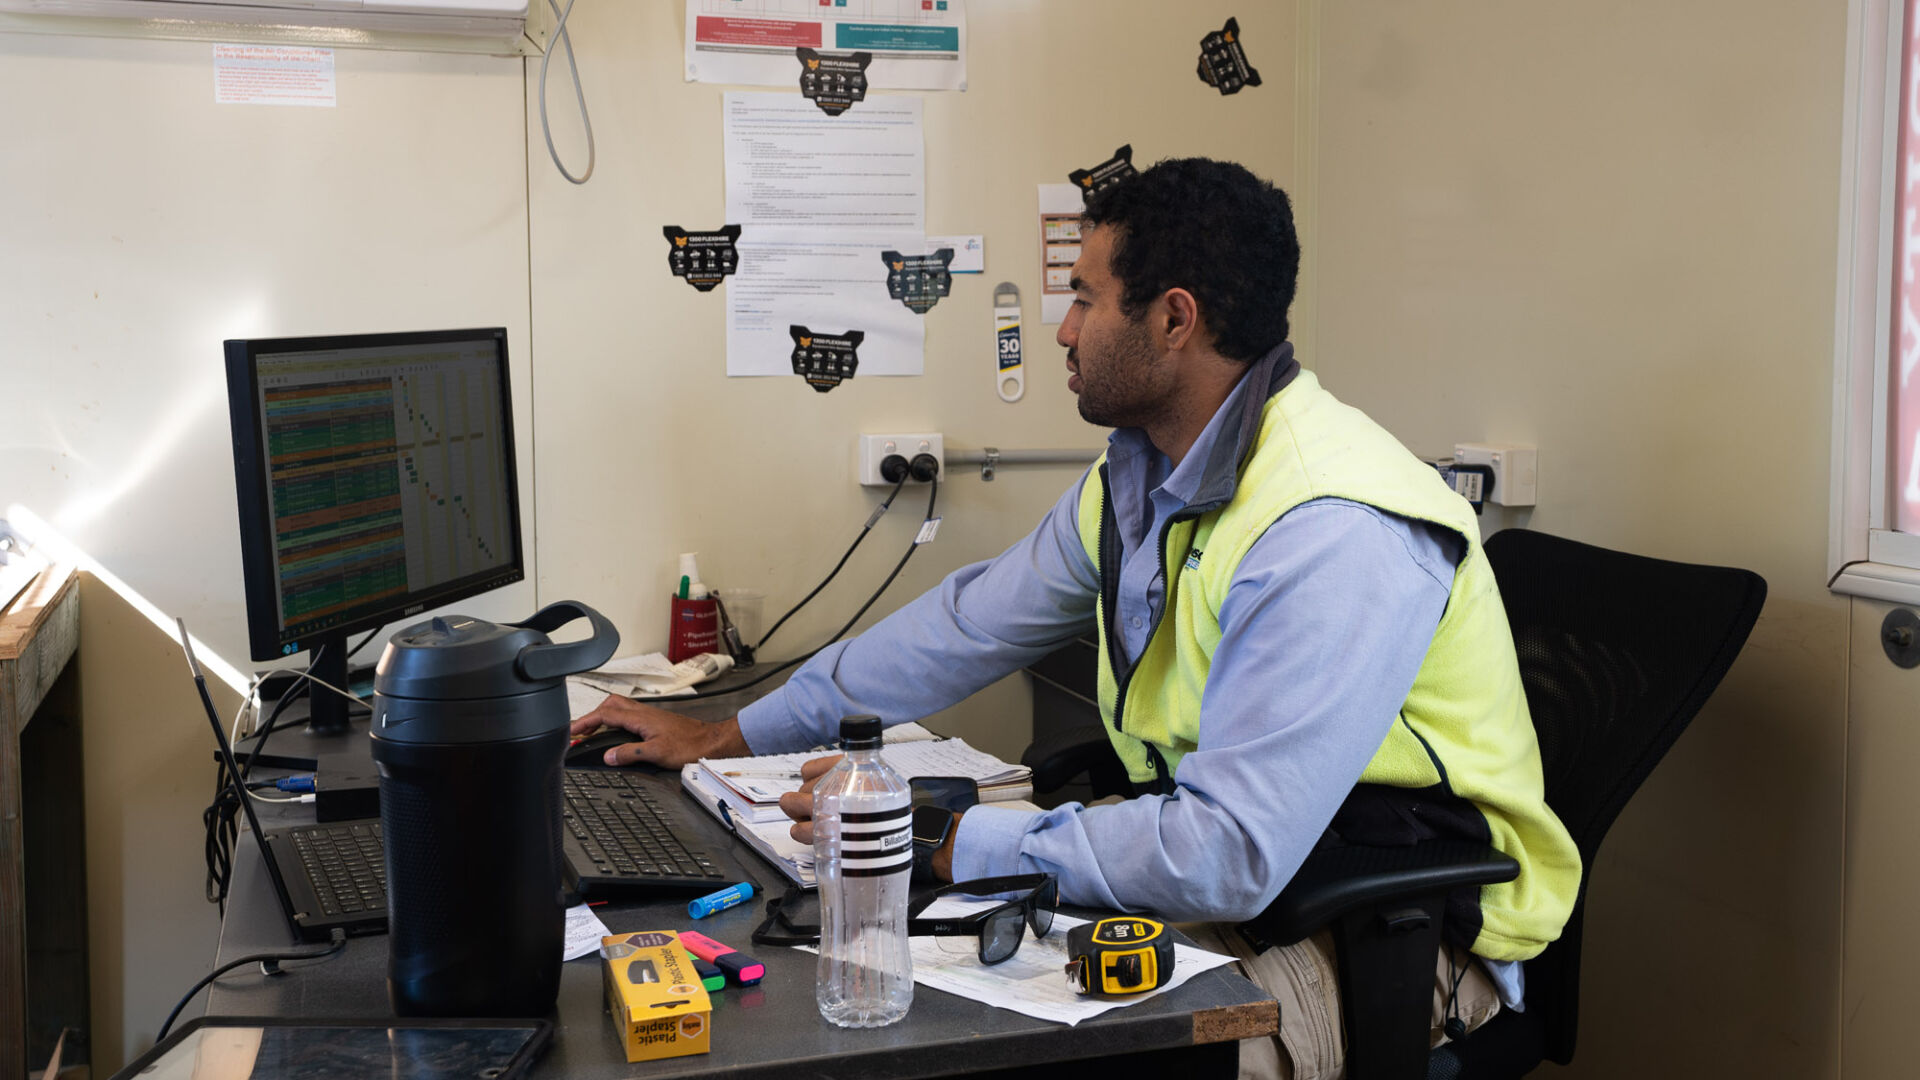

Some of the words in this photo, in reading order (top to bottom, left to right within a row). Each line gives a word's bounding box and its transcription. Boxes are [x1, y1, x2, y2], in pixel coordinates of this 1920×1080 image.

[1000, 339, 1020, 354] 30
[884, 831, 910, 847] Billabong
[1113, 924, 1130, 938] 8m
[660, 948, 678, 967] Stapler
[669, 967, 687, 984] Plastic
[634, 1021, 677, 1034] Stapler
[638, 1032, 677, 1046] Plastic
